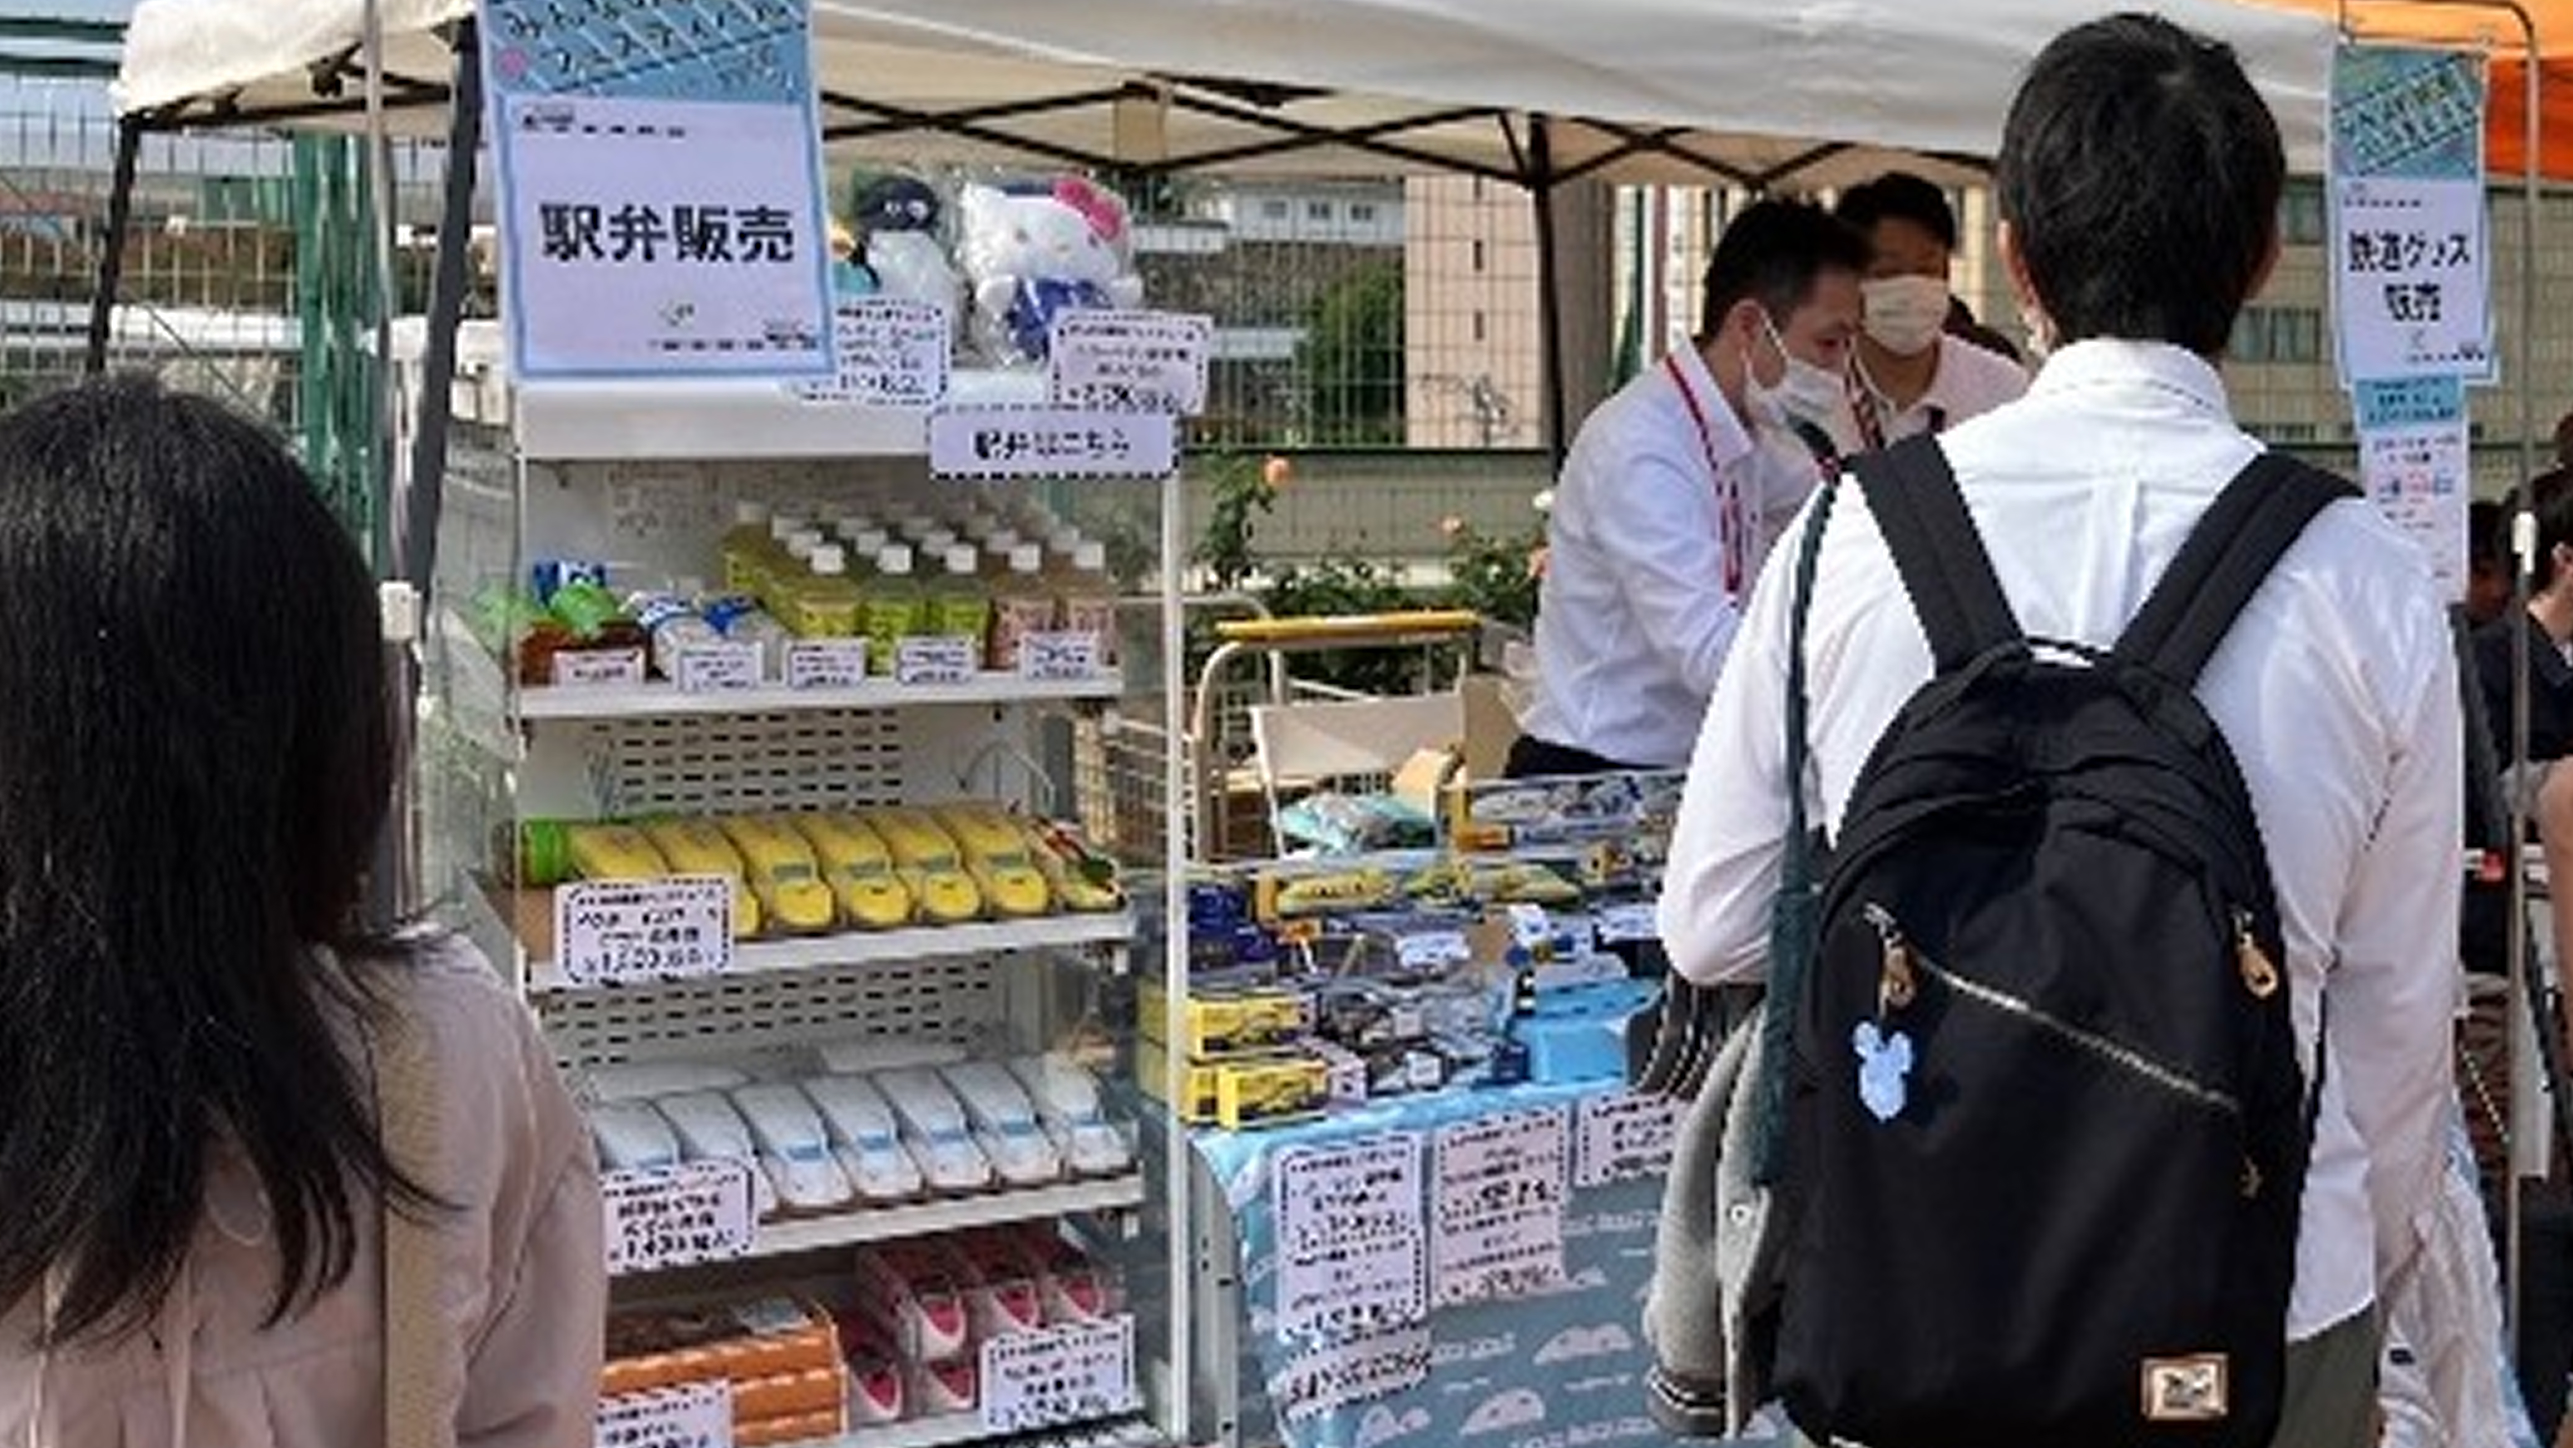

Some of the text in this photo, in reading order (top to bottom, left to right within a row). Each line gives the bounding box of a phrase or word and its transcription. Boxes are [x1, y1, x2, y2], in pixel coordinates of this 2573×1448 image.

[540, 202, 794, 262] 駅弁販売
[2385, 281, 2441, 321] 販売
[973, 428, 1130, 460] 駅弁はこちら
